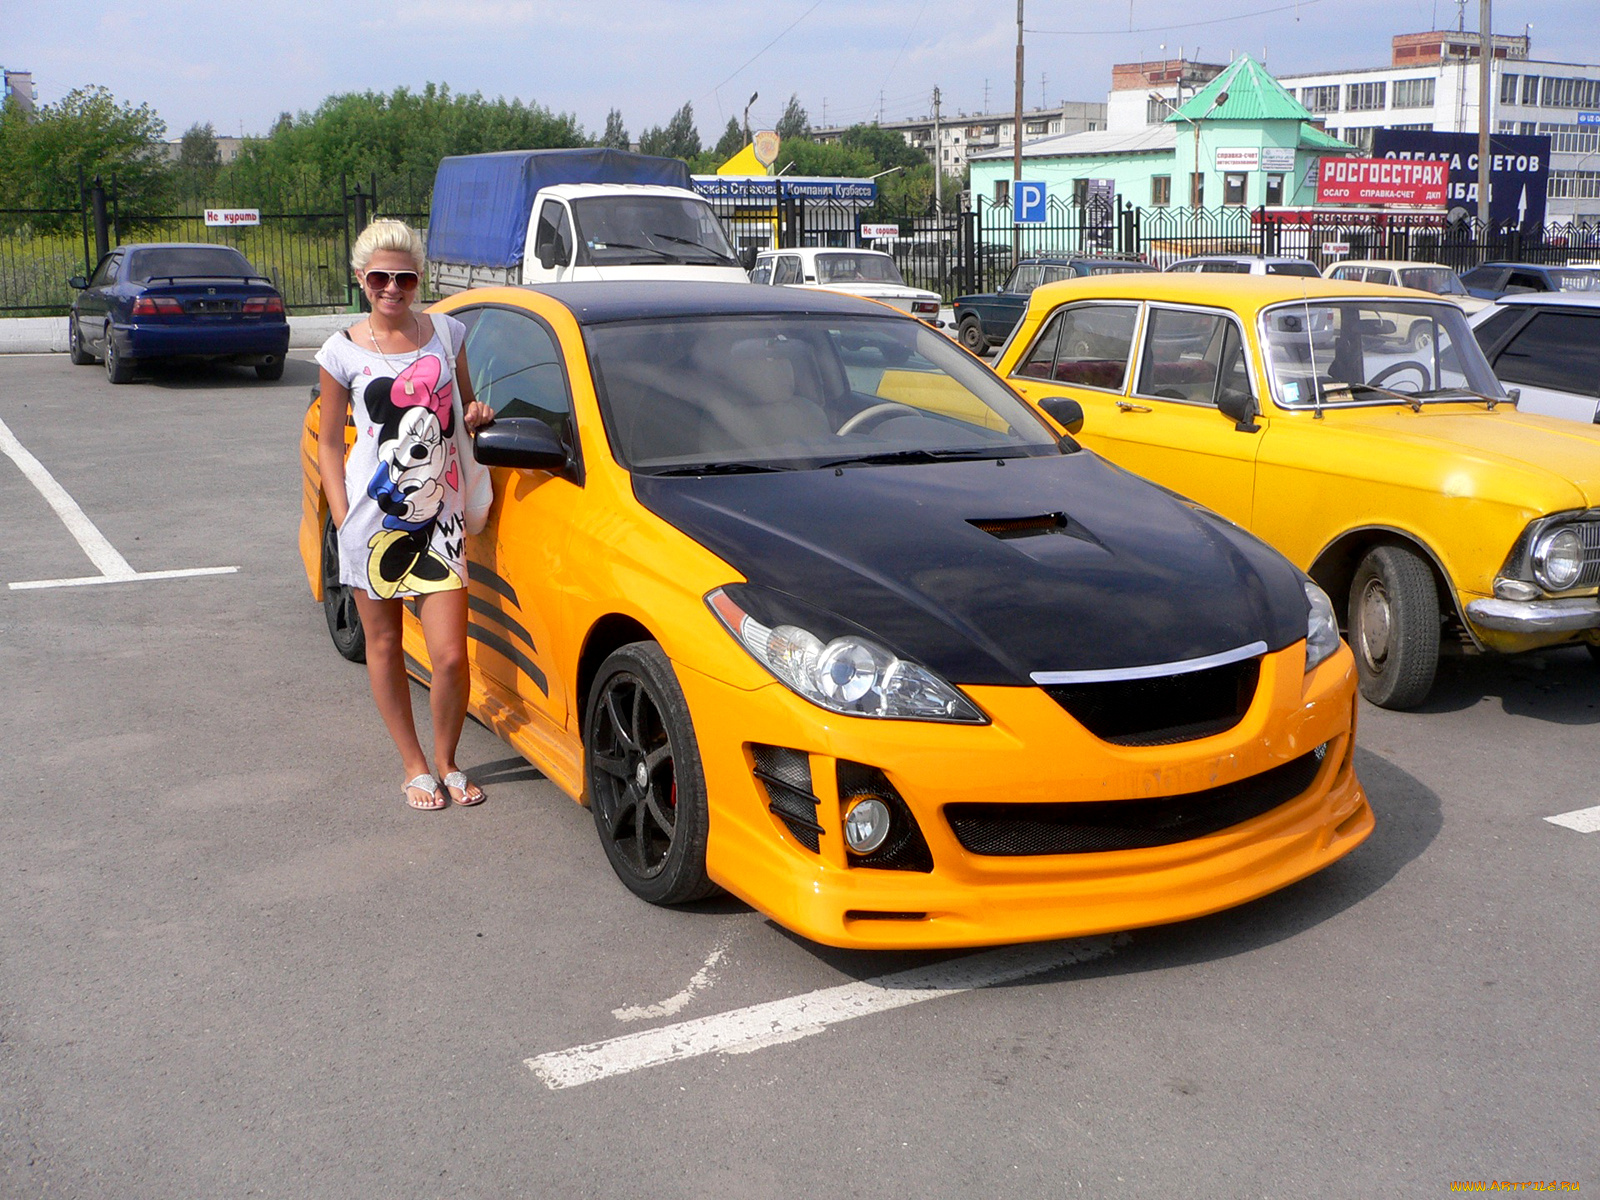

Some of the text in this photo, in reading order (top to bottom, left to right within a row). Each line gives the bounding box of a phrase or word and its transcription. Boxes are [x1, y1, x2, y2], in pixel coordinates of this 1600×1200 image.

[1468, 154, 1539, 172] СЕТОВ
[1324, 162, 1443, 185] РОСГОССТРАХ
[788, 185, 833, 198] Компания
[835, 184, 872, 198] Кузбасса
[1323, 188, 1441, 200] ОСАГО СПРАВКА-СЧЕТ ДКП
[1022, 186, 1041, 219] P
[207, 211, 257, 224] Не курить
[863, 226, 872, 235] Не
